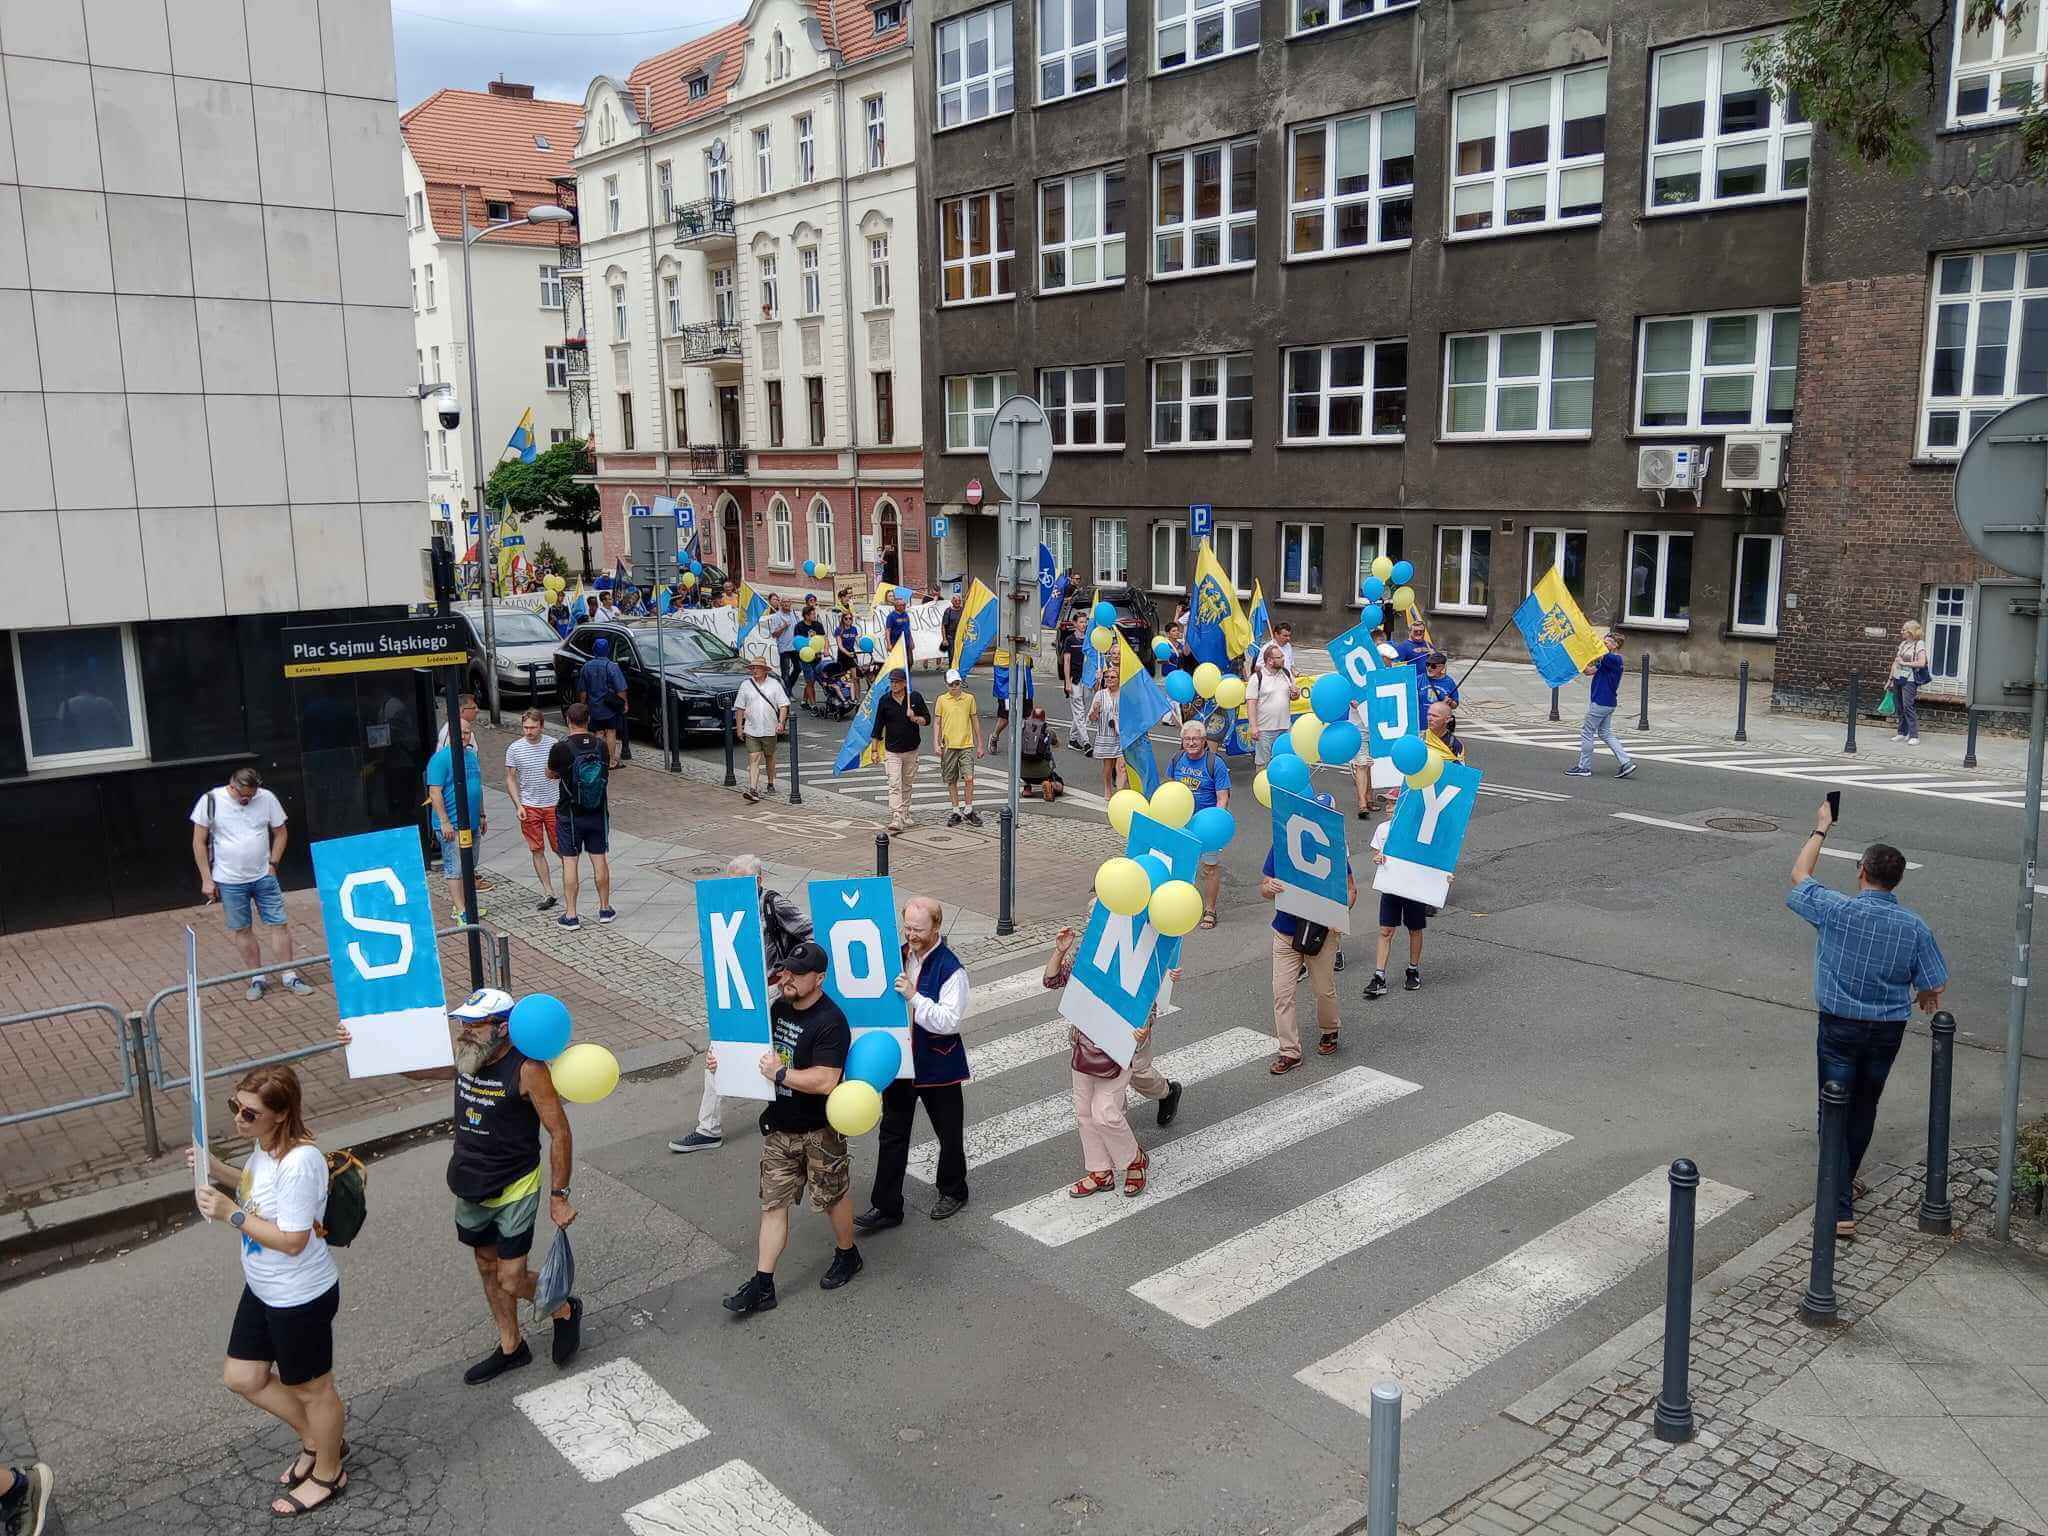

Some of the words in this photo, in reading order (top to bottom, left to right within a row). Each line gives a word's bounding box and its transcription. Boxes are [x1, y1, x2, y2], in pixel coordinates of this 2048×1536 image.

[678, 510, 690, 527] P
[935, 519, 946, 536] P
[1194, 508, 1207, 533] P
[293, 643, 325, 658] Plac
[329, 640, 375, 657] Sejmu
[379, 634, 448, 654] Śląskiego
[1375, 682, 1408, 740] J
[1416, 784, 1463, 845] Y
[1286, 813, 1332, 881] C
[339, 866, 414, 981] S
[709, 909, 756, 1010] K
[1092, 910, 1160, 998] N
